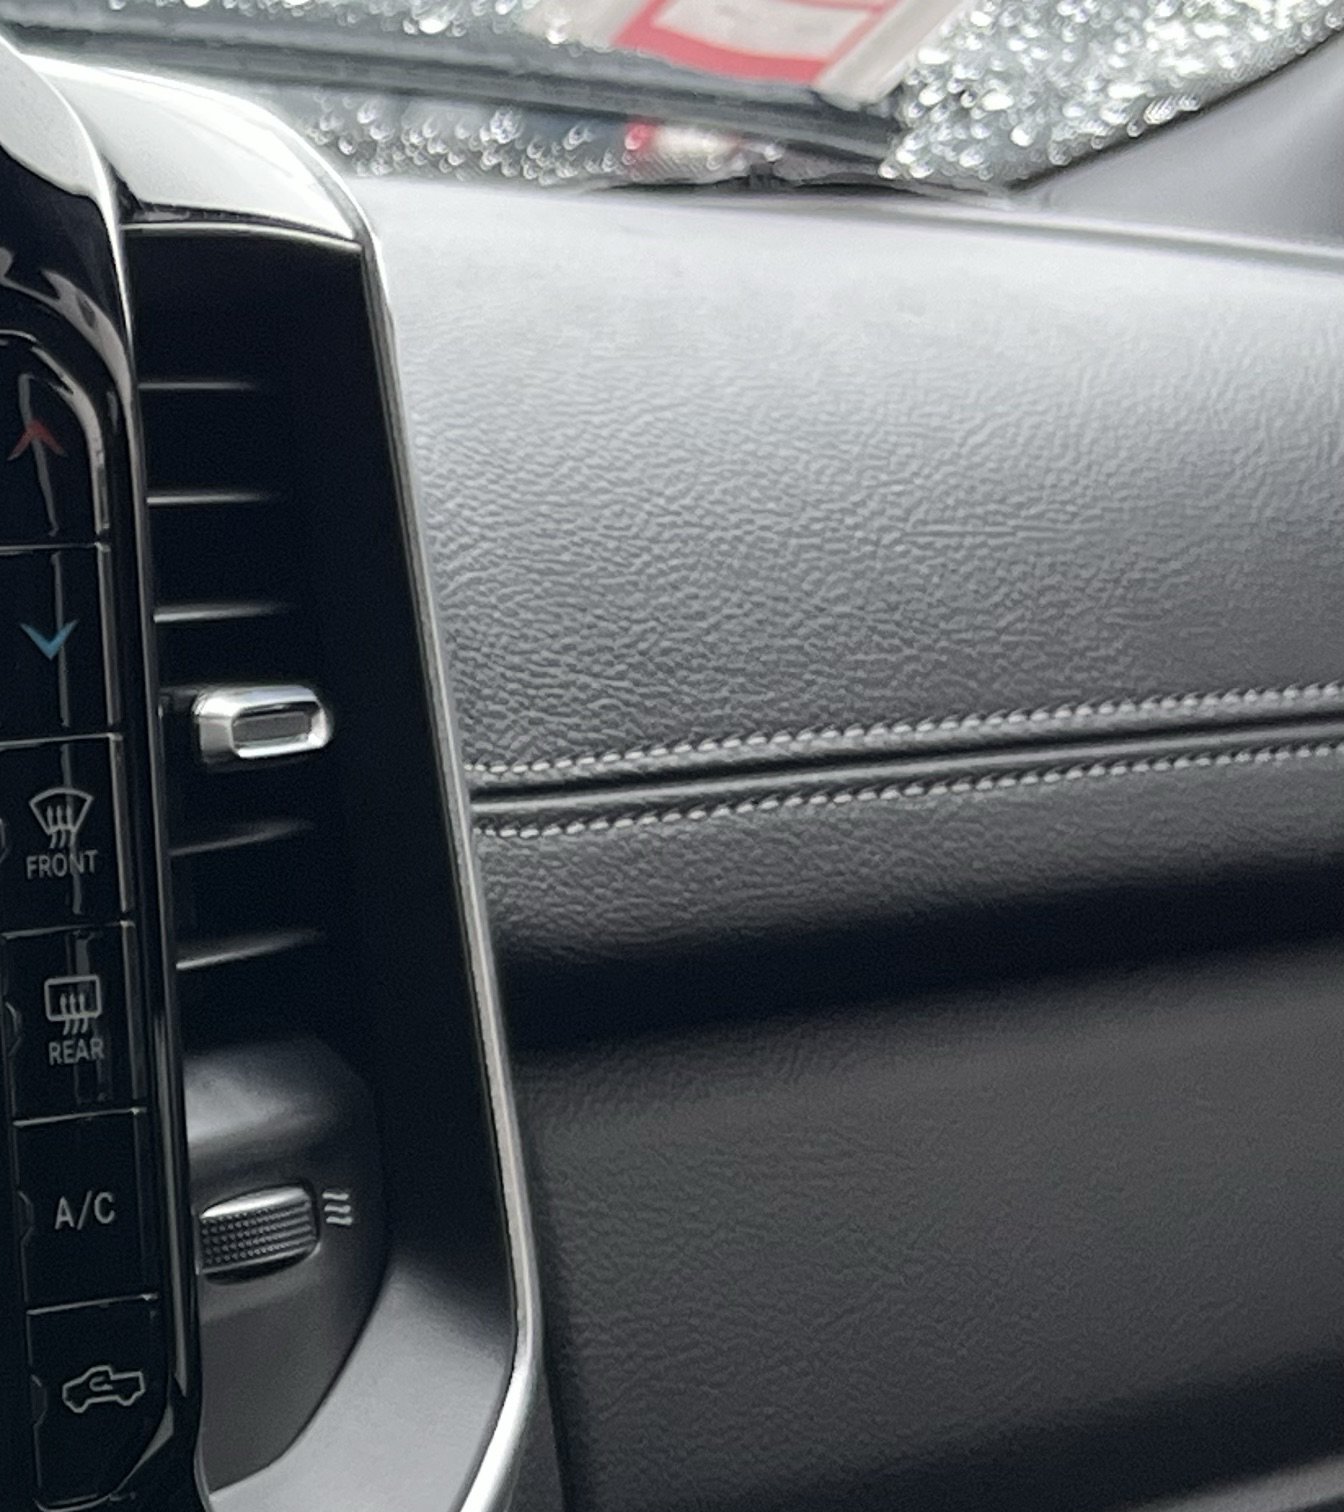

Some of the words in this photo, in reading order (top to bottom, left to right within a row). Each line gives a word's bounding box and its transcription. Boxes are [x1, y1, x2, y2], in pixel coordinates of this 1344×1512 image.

[26, 848, 98, 881] FRONT
[48, 1037, 105, 1067] REAR
[54, 1190, 116, 1231] A/C
